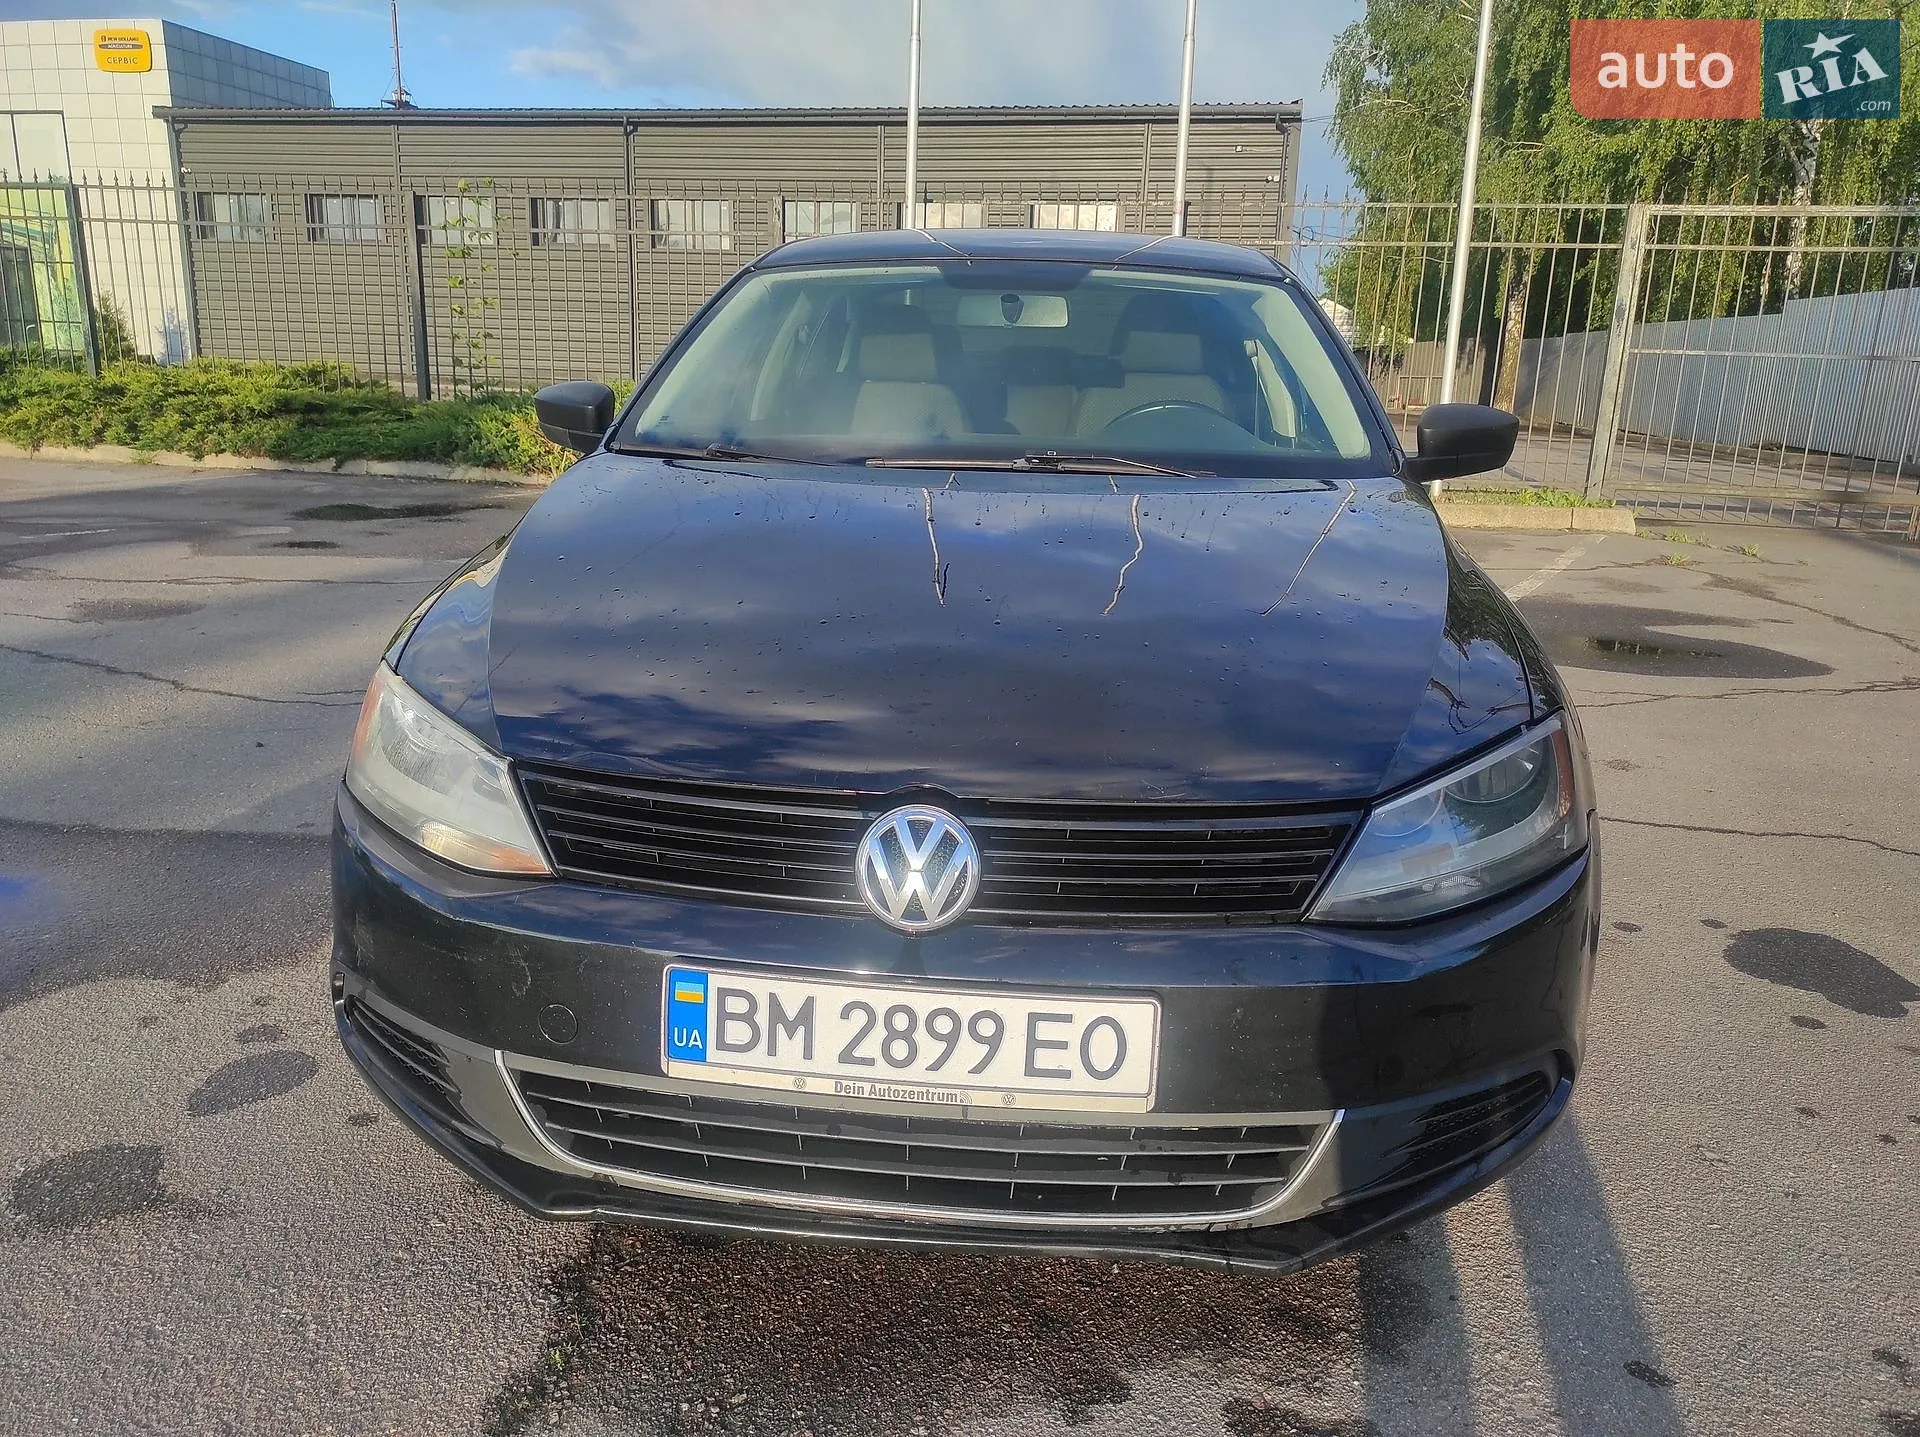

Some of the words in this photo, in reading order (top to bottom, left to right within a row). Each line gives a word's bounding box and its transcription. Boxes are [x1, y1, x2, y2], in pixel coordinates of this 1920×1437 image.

[673, 1027, 704, 1049] UA
[716, 986, 815, 1061] BM
[838, 1000, 1005, 1075] 2899
[1024, 1011, 1128, 1081] EO
[834, 1080, 865, 1096] Dein
[868, 1084, 958, 1103] Autozentrum
